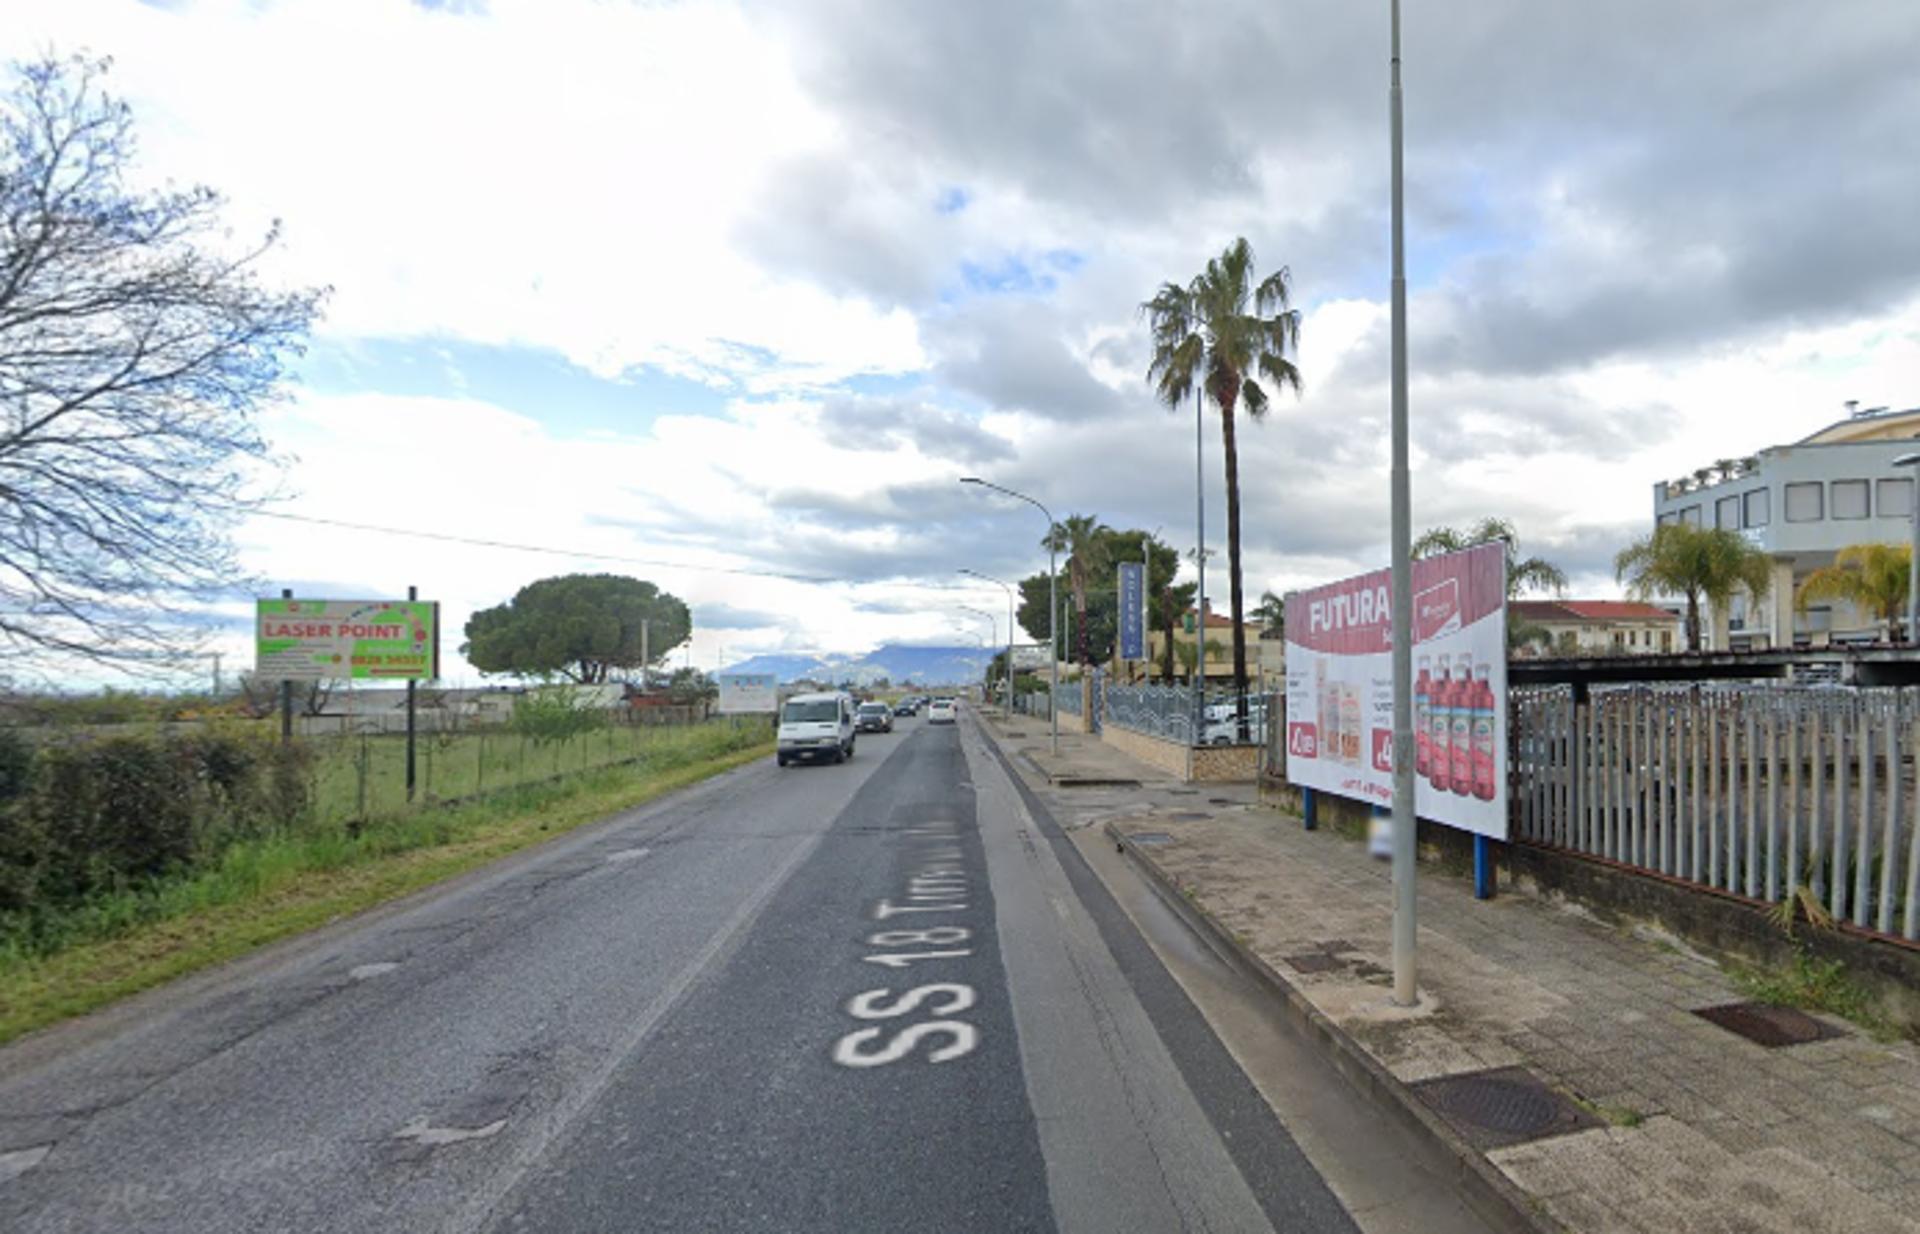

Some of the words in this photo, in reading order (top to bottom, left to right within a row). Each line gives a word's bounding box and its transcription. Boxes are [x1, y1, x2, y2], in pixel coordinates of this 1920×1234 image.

[1309, 586, 1391, 634] FUTURA
[264, 623, 331, 638] LASER
[338, 624, 402, 638] POINT
